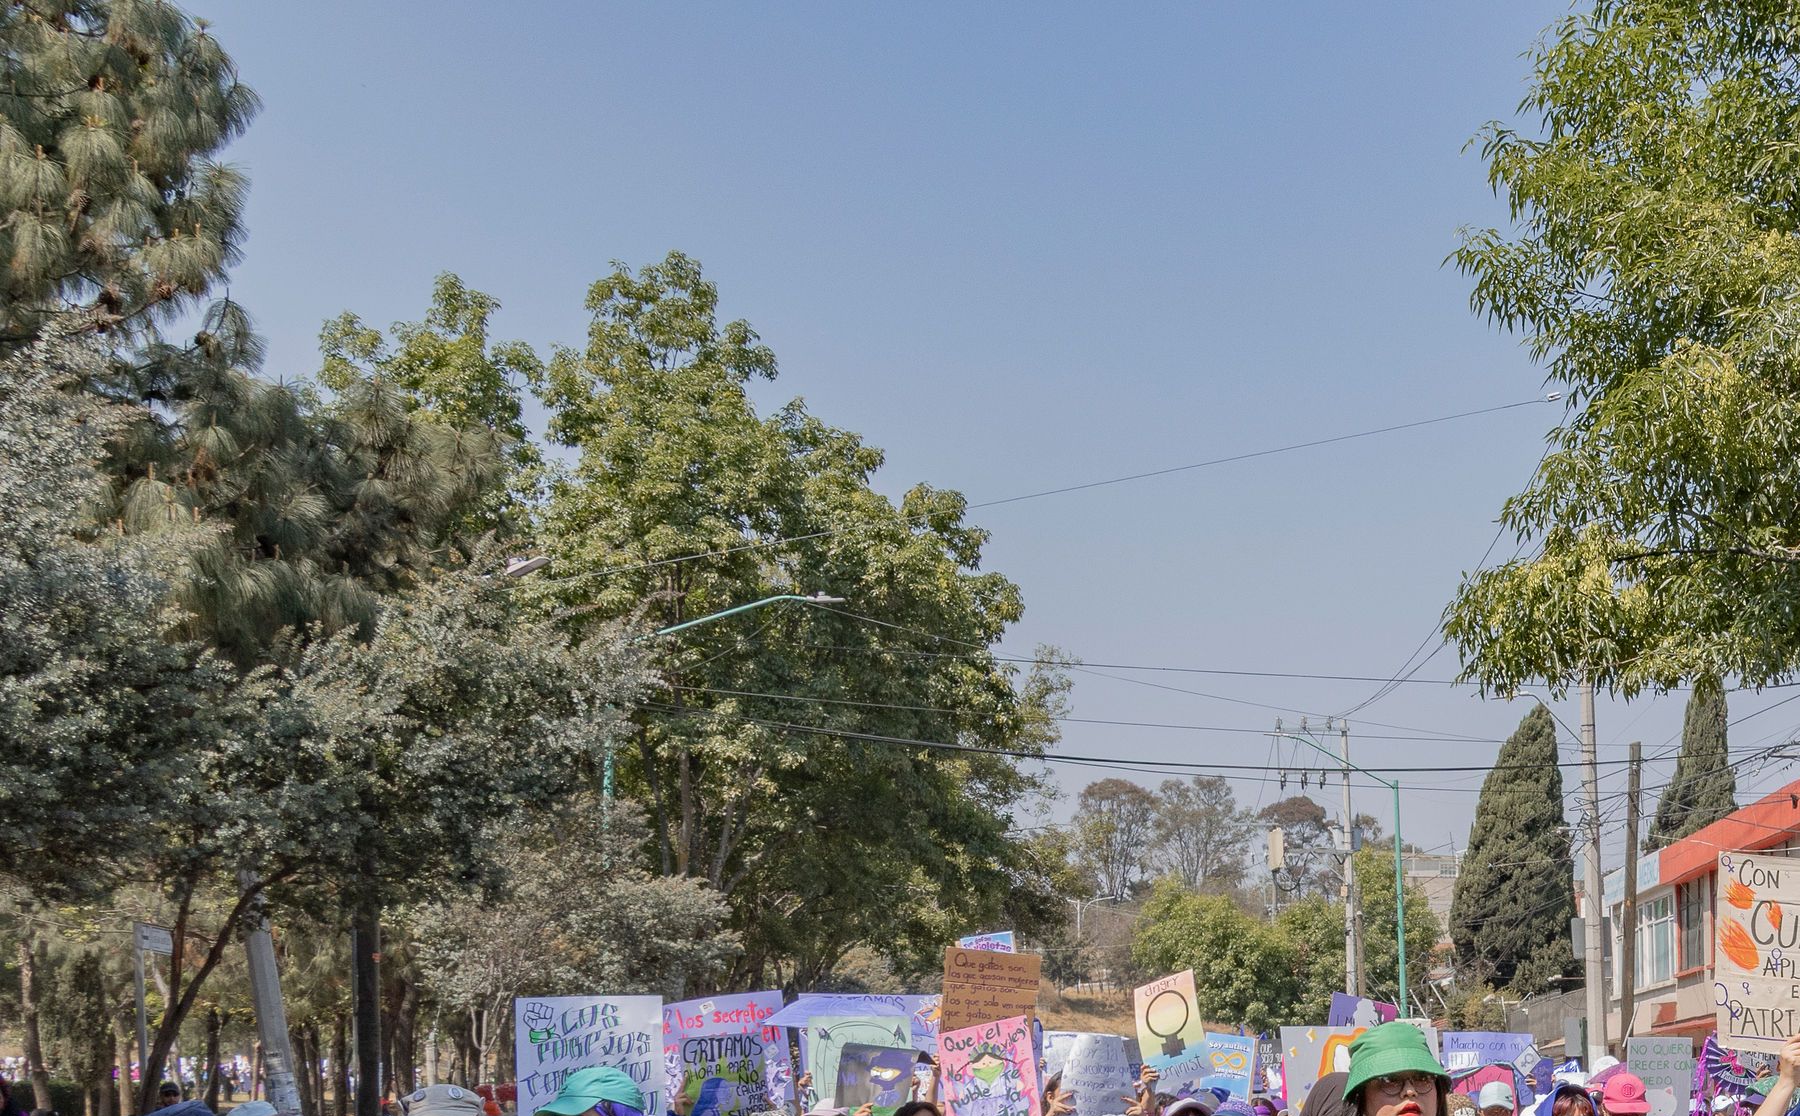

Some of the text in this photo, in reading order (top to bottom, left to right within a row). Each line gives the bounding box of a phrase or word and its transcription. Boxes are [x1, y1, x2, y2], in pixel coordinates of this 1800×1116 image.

[1739, 859, 1780, 889] CON
[954, 952, 976, 968] Que
[978, 957, 1004, 972] gatos
[947, 964, 960, 977] los
[962, 973, 976, 983] que
[950, 983, 966, 993] que
[971, 980, 998, 994] gatos
[946, 991, 961, 1006] los
[965, 999, 979, 1010] que
[675, 1007, 704, 1031] los
[713, 1000, 773, 1024] secretos
[944, 1010, 960, 1021] que
[943, 1022, 1001, 1052] Que el
[1450, 1037, 1485, 1050] Marcho
[1488, 1042, 1507, 1051] con
[682, 1033, 764, 1065] GRITAMOS
[1630, 1043, 1693, 1056] NO QUIERO
[1450, 1052, 1479, 1067] HIJA
[1628, 1059, 1670, 1071] CRECER
[684, 1059, 755, 1084] AHORA PARA
[738, 1069, 760, 1085] NO
